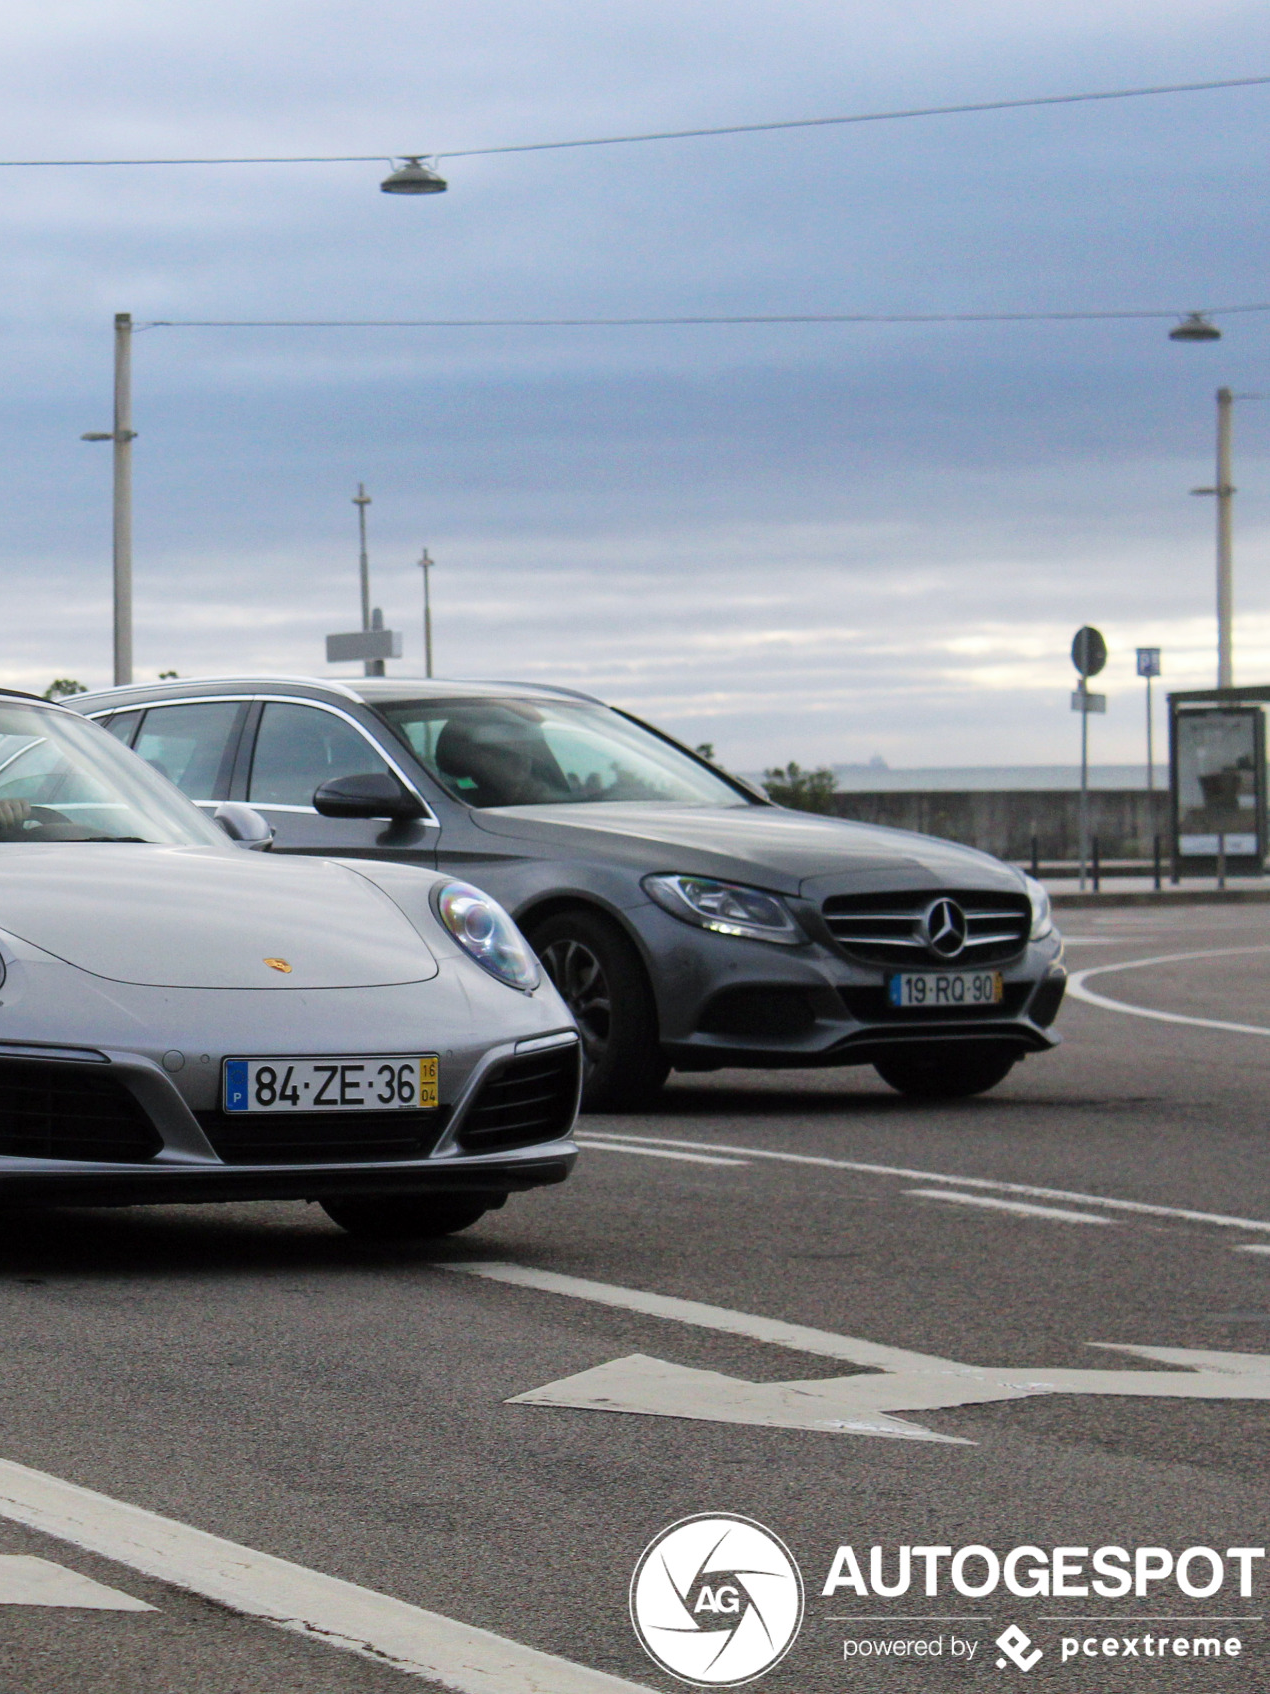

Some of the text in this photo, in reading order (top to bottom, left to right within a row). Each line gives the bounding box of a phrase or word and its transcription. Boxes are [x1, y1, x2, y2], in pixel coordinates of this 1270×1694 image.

[423, 1063, 436, 1078] 16
[233, 1092, 242, 1103] P
[421, 1089, 436, 1103] 04
